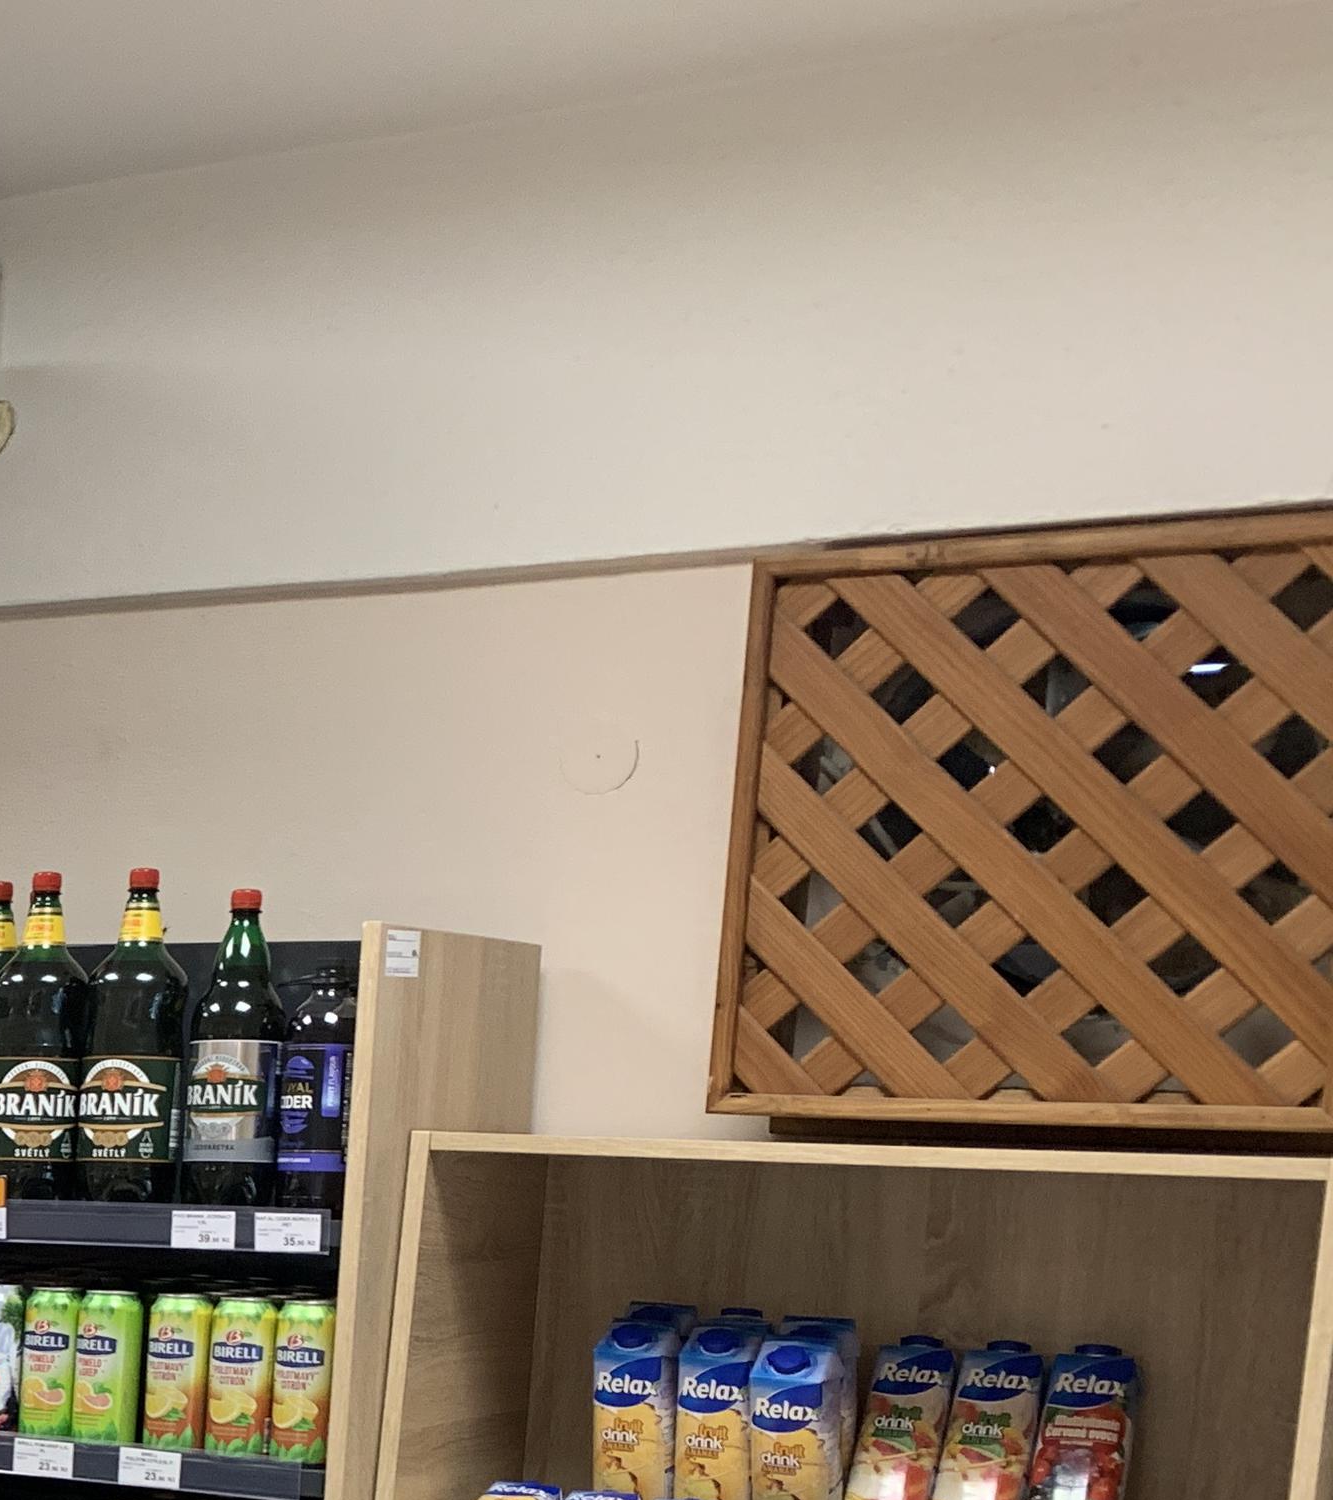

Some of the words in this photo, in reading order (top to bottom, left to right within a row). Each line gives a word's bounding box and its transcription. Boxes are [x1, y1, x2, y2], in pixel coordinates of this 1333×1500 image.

[80, 1088, 158, 1118] BRANÍK
[14, 1145, 51, 1159] SVĚTLÝ
[92, 1145, 126, 1159] SVĚTLÝ
[149, 1341, 190, 1356] BIRELL
[213, 1344, 260, 1361] BIRELL
[277, 1349, 321, 1365] BIRELL
[880, 1363, 943, 1386] Relax
[966, 1368, 1033, 1391] Relax
[597, 1372, 656, 1397] Relax
[683, 1377, 744, 1402] Relax
[1055, 1372, 1125, 1397] Relax
[755, 1398, 819, 1421] Relax
[874, 1416, 915, 1431] drink
[962, 1423, 1004, 1438] drink
[602, 1428, 638, 1444] drink
[685, 1434, 722, 1449] drink
[761, 1453, 800, 1468] drink
[491, 1482, 548, 1499] Relax
